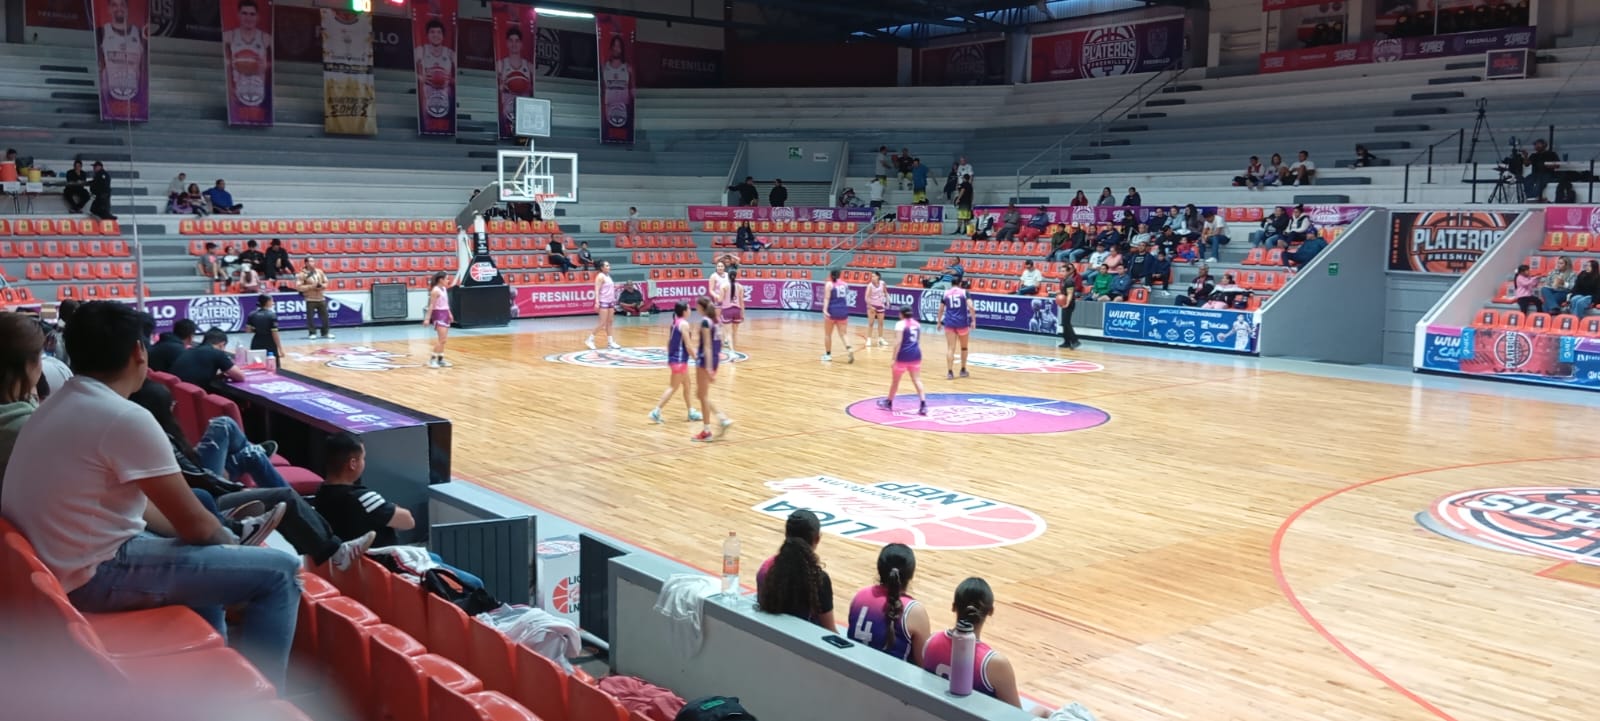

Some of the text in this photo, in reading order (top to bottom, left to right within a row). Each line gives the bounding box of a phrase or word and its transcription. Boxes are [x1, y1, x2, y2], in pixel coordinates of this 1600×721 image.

[1083, 40, 1137, 65] PLATEROS
[661, 57, 715, 72] FRESNILLO
[532, 290, 596, 303] FRESNILLO
[656, 287, 707, 298] RESNILLO
[888, 292, 914, 305] NILLO
[921, 298, 944, 310] PLATE
[949, 294, 961, 308] 15
[974, 300, 1018, 314] ESNILLO
[190, 306, 241, 320] PLATEROS
[1109, 309, 1141, 321] WINTER
[1112, 319, 1137, 328] CAMP
[909, 327, 918, 341] 5
[1433, 335, 1461, 347] WIN
[1438, 347, 1461, 357] CA
[1506, 331, 1517, 369] PLATEROS
[873, 482, 997, 511] LNBP
[568, 604, 580, 613] LN
[854, 606, 873, 645] 4
